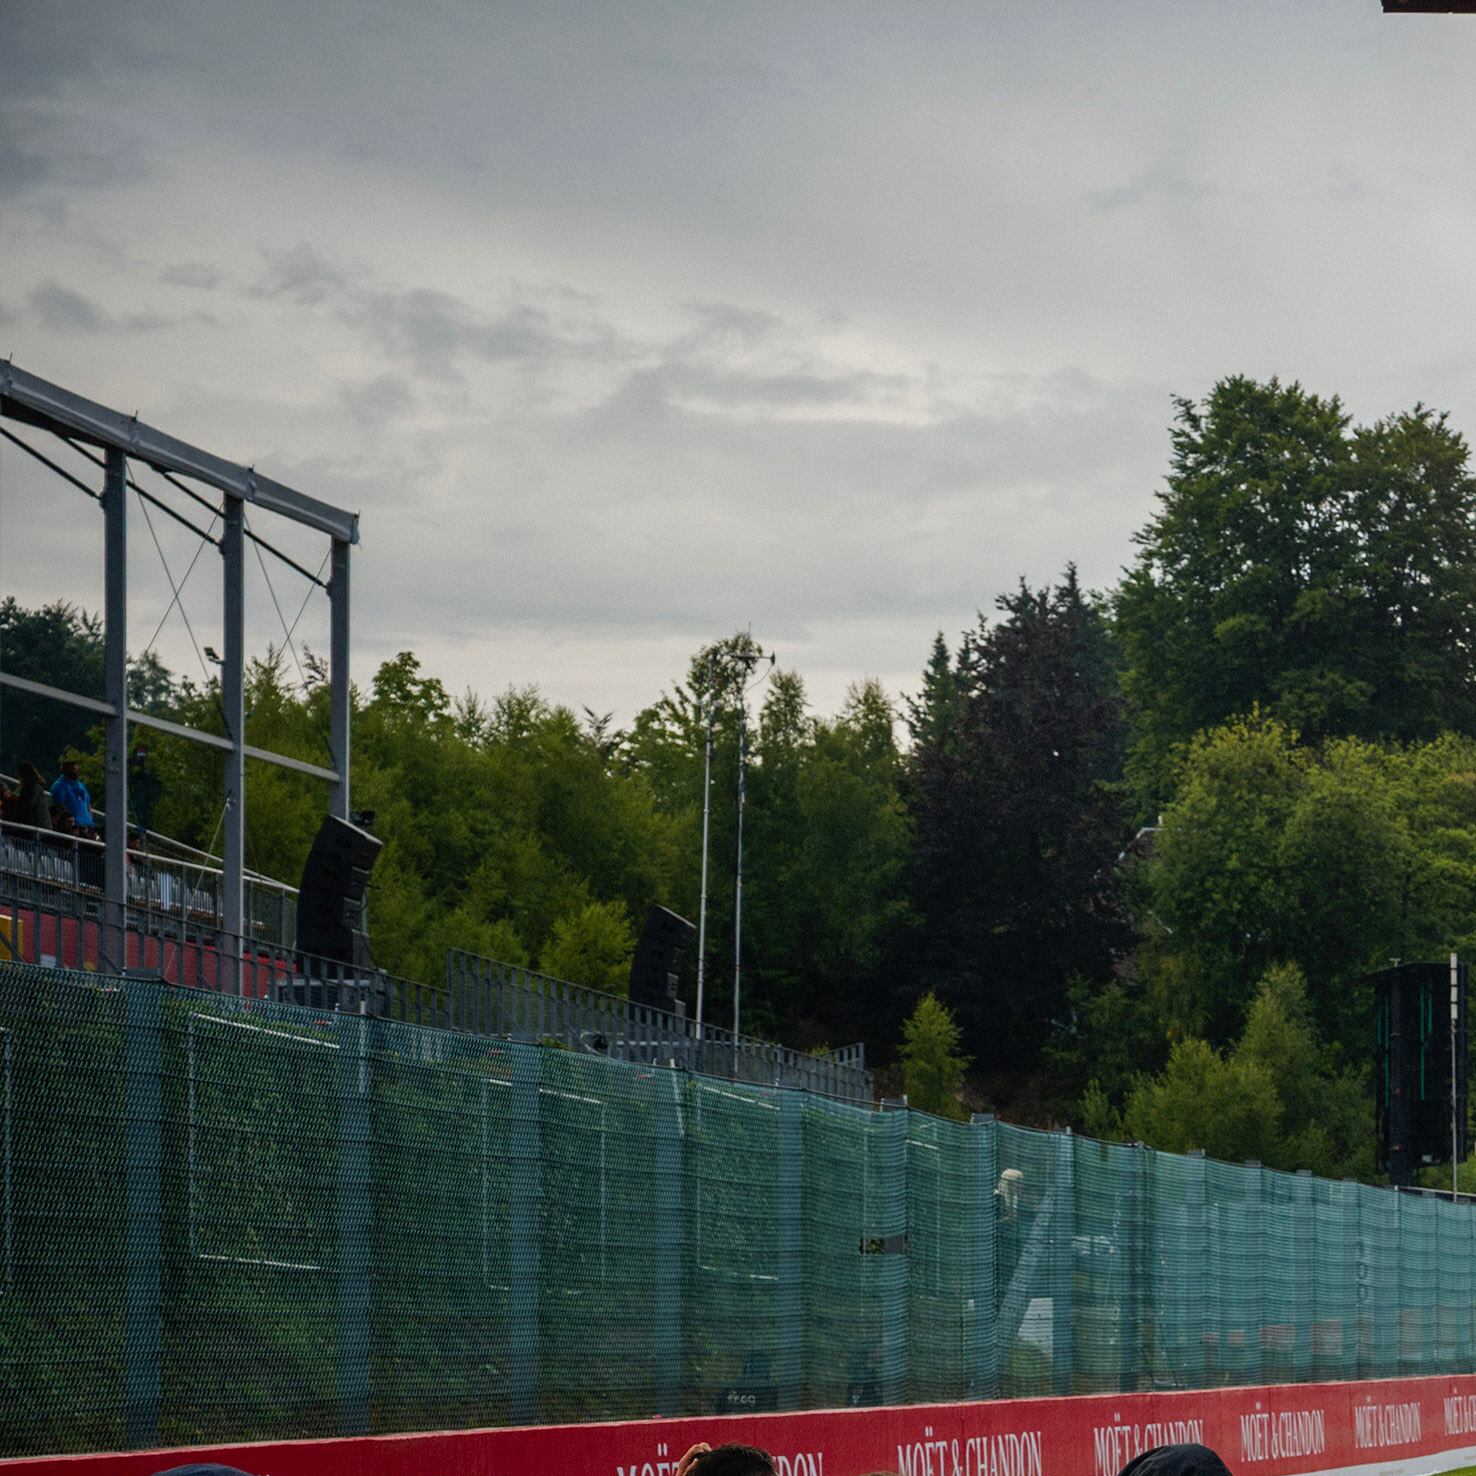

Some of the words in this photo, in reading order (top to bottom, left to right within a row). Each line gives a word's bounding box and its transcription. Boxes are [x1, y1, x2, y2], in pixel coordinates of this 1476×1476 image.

[1241, 1402, 1270, 1463] MOËT
[1271, 1412, 1278, 1459] &
[1278, 1409, 1325, 1458] CHANDON
[1355, 1396, 1378, 1449] MOËT
[1378, 1406, 1385, 1447] &
[1385, 1402, 1421, 1446] CHANDON
[1444, 1388, 1463, 1436] MOËT
